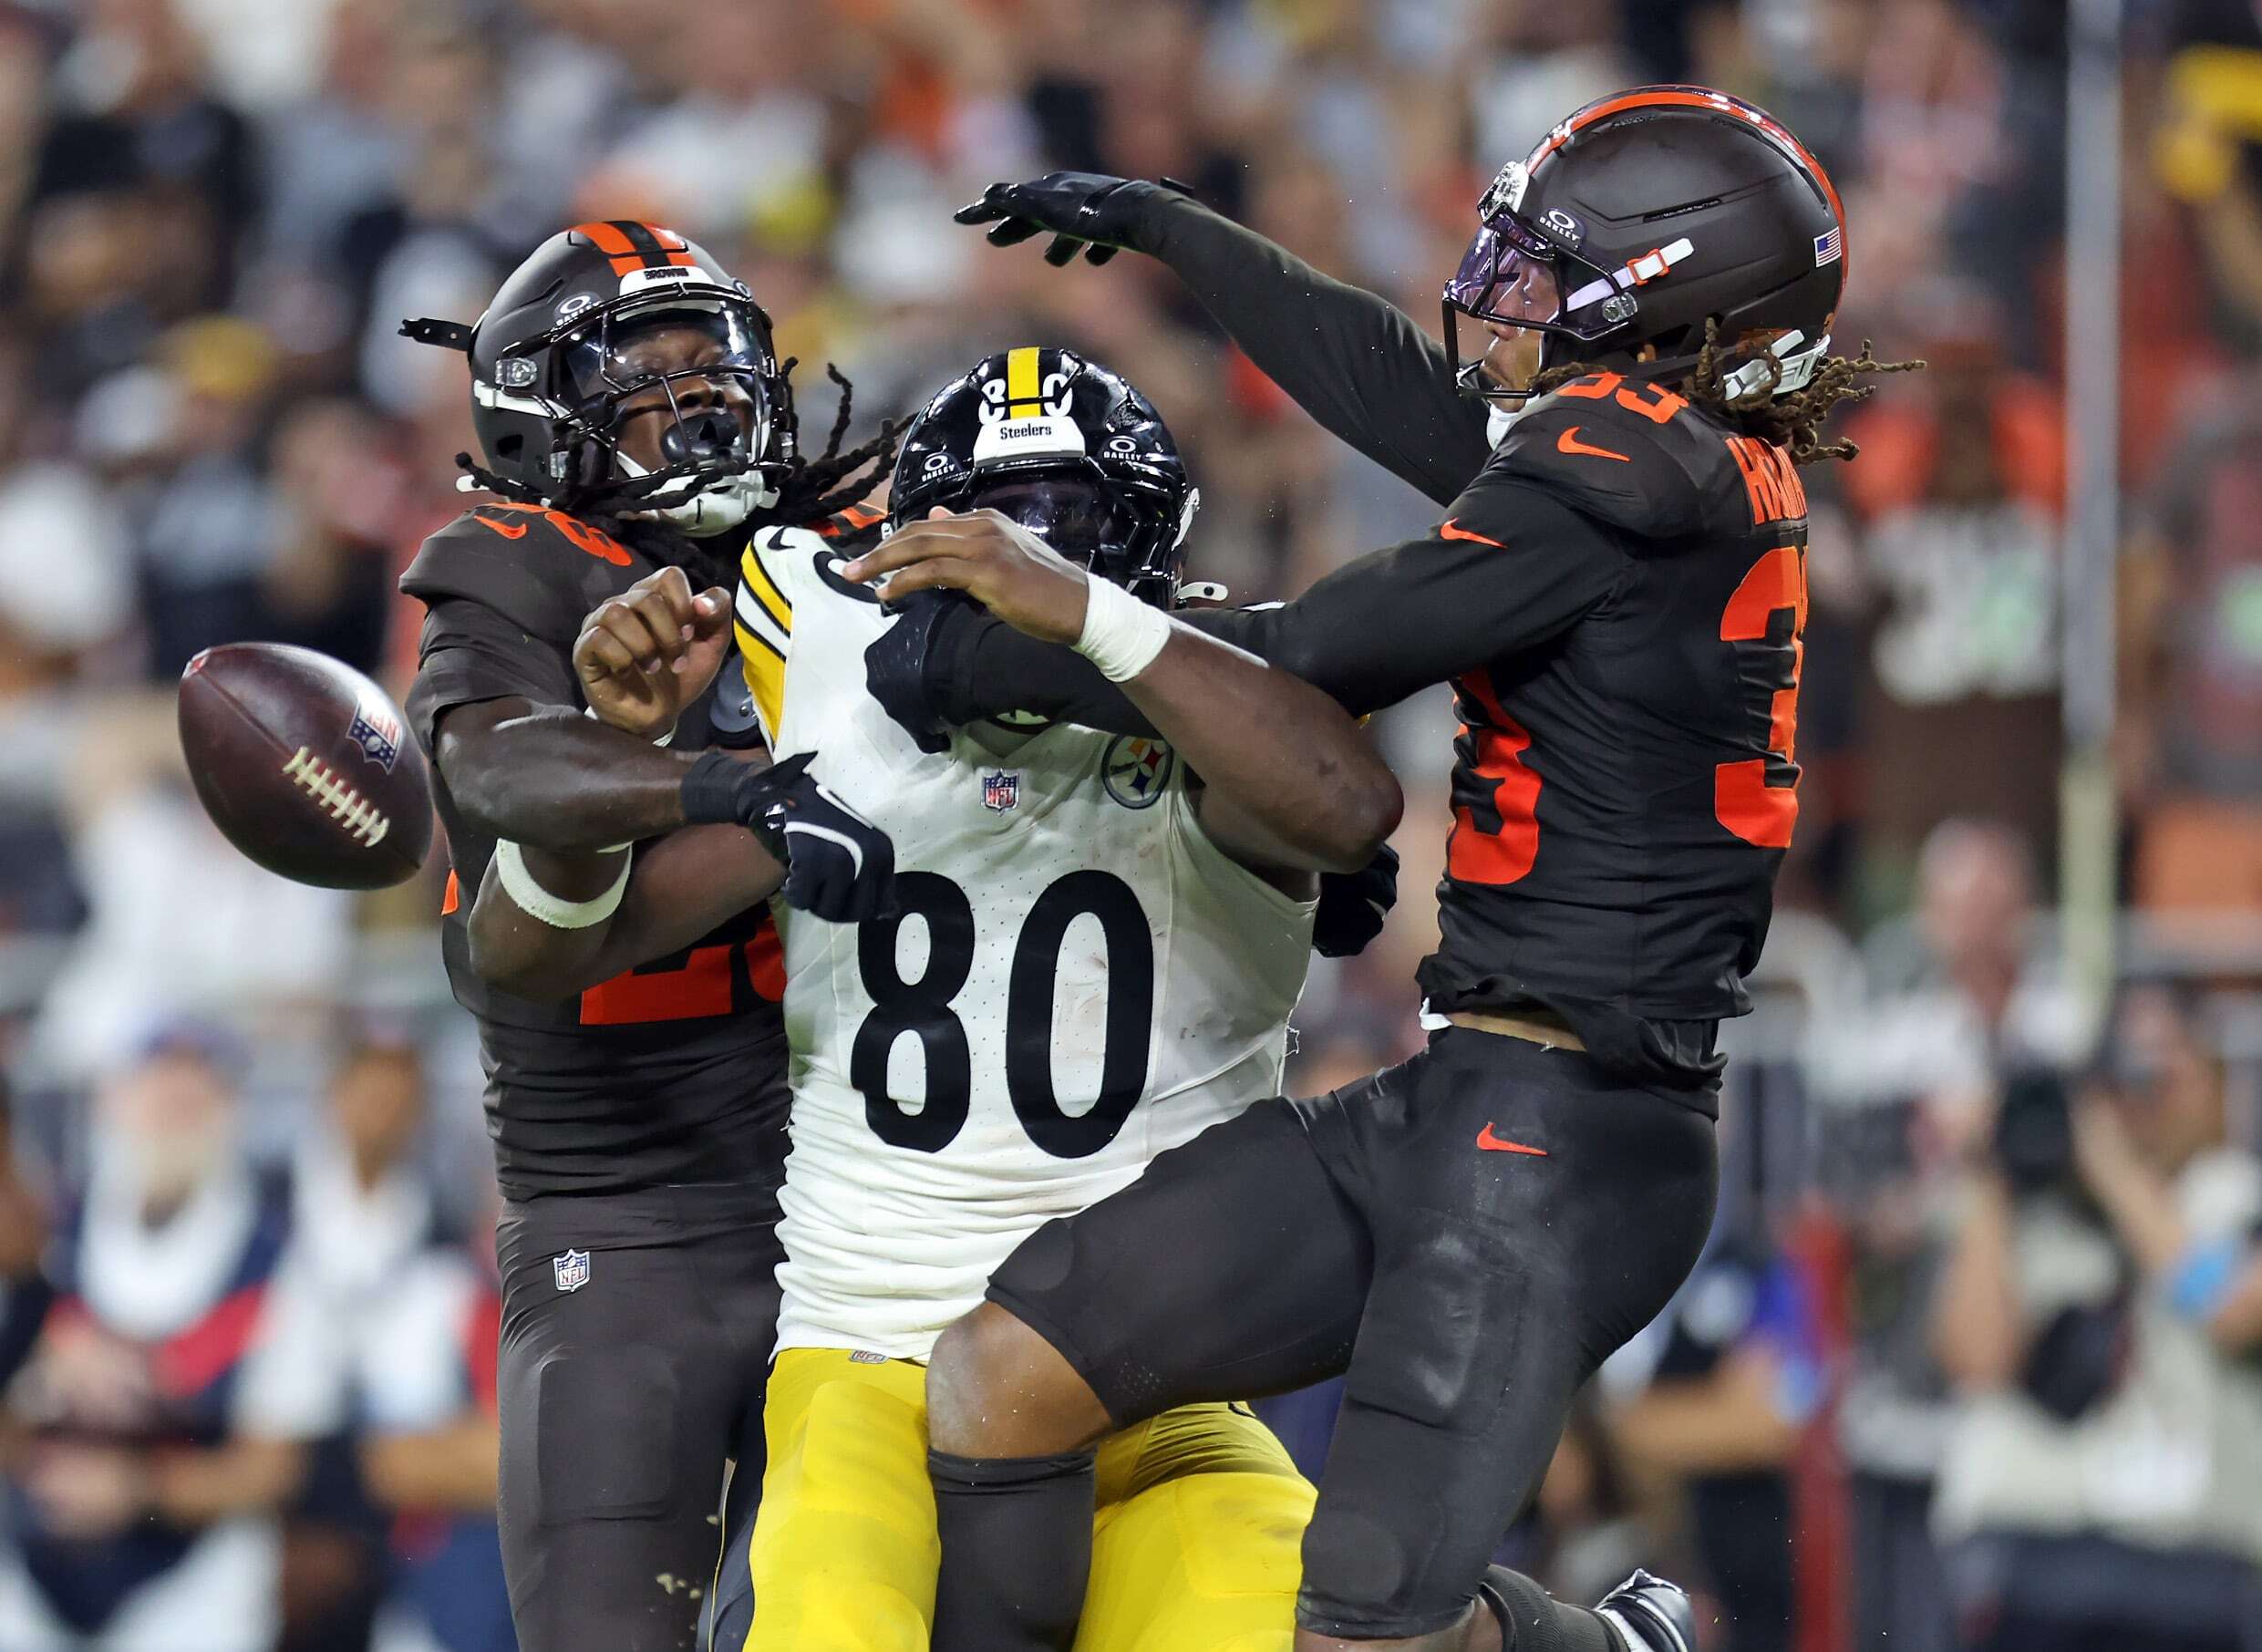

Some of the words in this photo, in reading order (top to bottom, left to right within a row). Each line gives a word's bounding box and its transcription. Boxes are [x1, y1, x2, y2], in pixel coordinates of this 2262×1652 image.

[1539, 216, 1581, 242] OAKLEY
[978, 372, 1073, 427] 80
[999, 423, 1052, 439] Steelers
[1103, 450, 1141, 461] OAKLEY
[921, 463, 956, 482] OAKLEY
[986, 787, 1014, 806] NFL
[850, 869, 1154, 1160] 80
[561, 1266, 585, 1285] NFL
